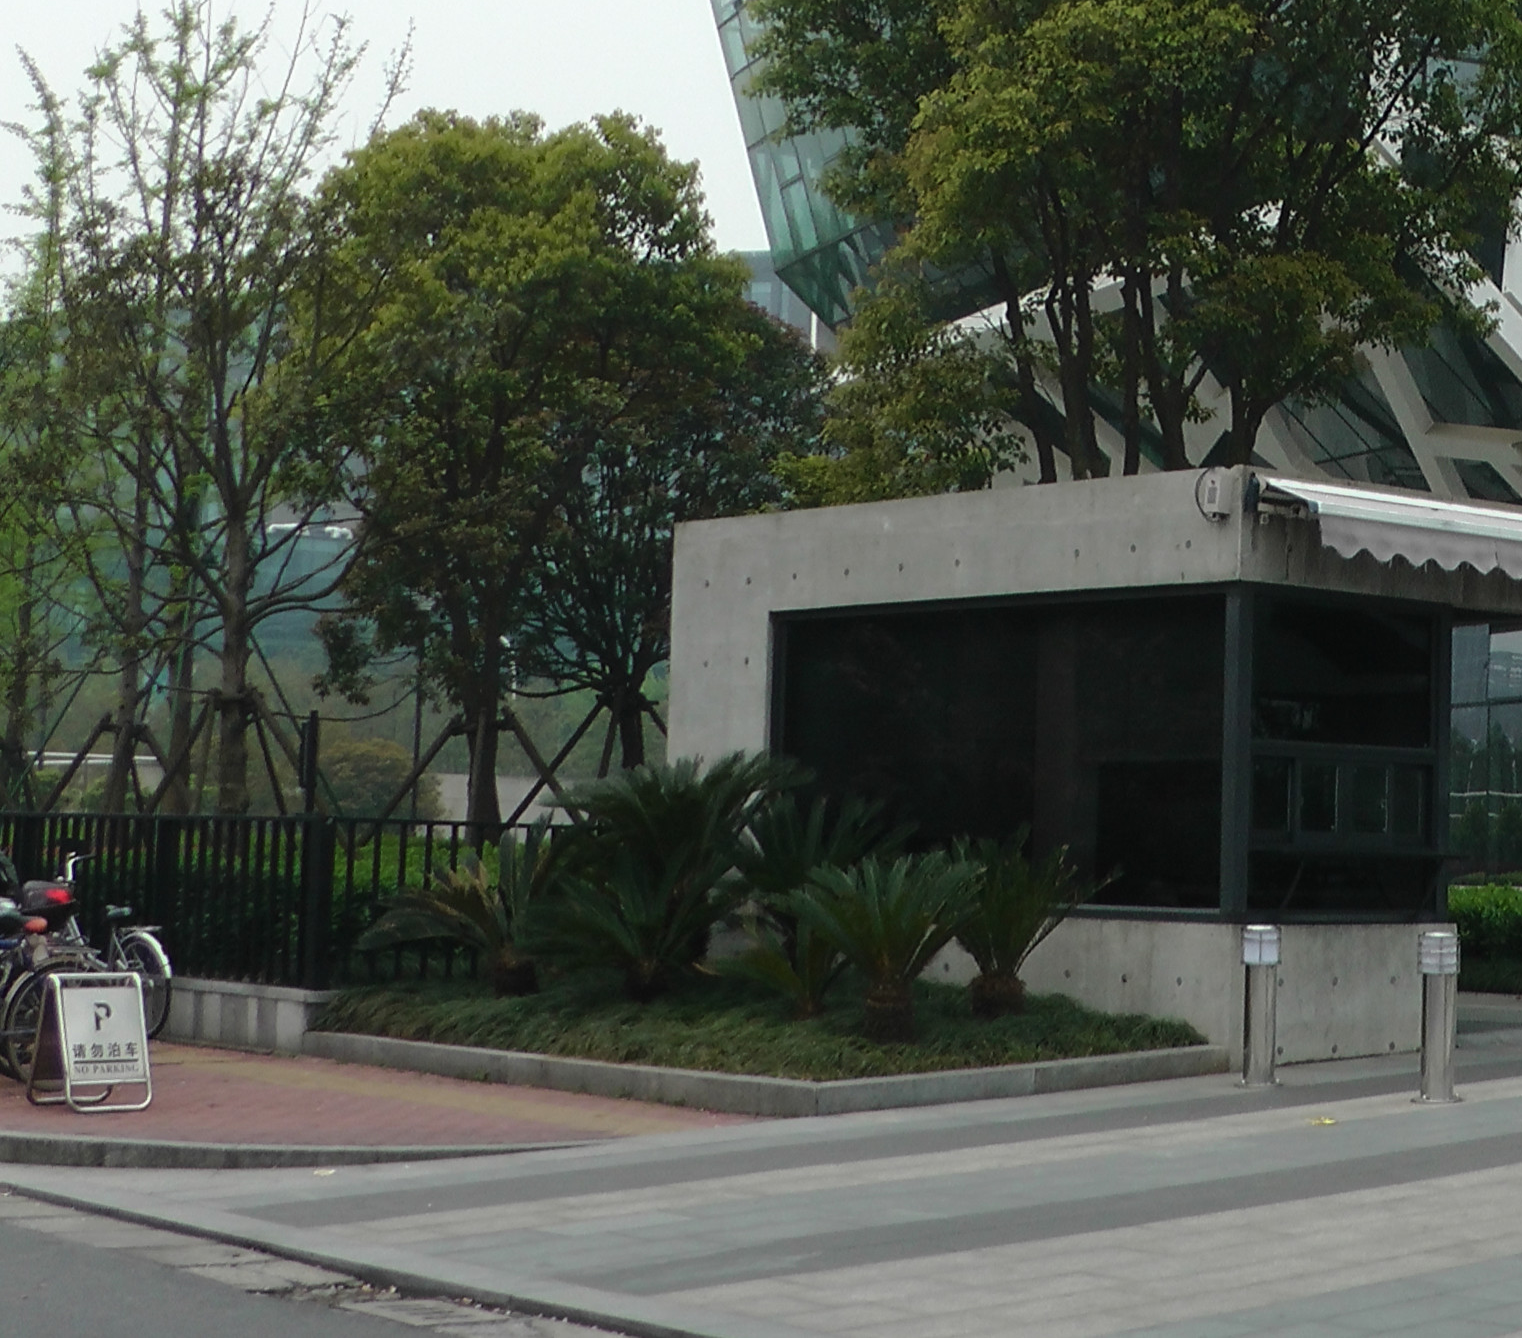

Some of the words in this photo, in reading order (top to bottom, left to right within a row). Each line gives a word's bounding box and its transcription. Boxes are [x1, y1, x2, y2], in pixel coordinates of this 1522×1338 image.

[72, 1041, 138, 1059] 请勿泊车
[74, 1064, 89, 1074] NO
[93, 1063, 139, 1074] PARKING
